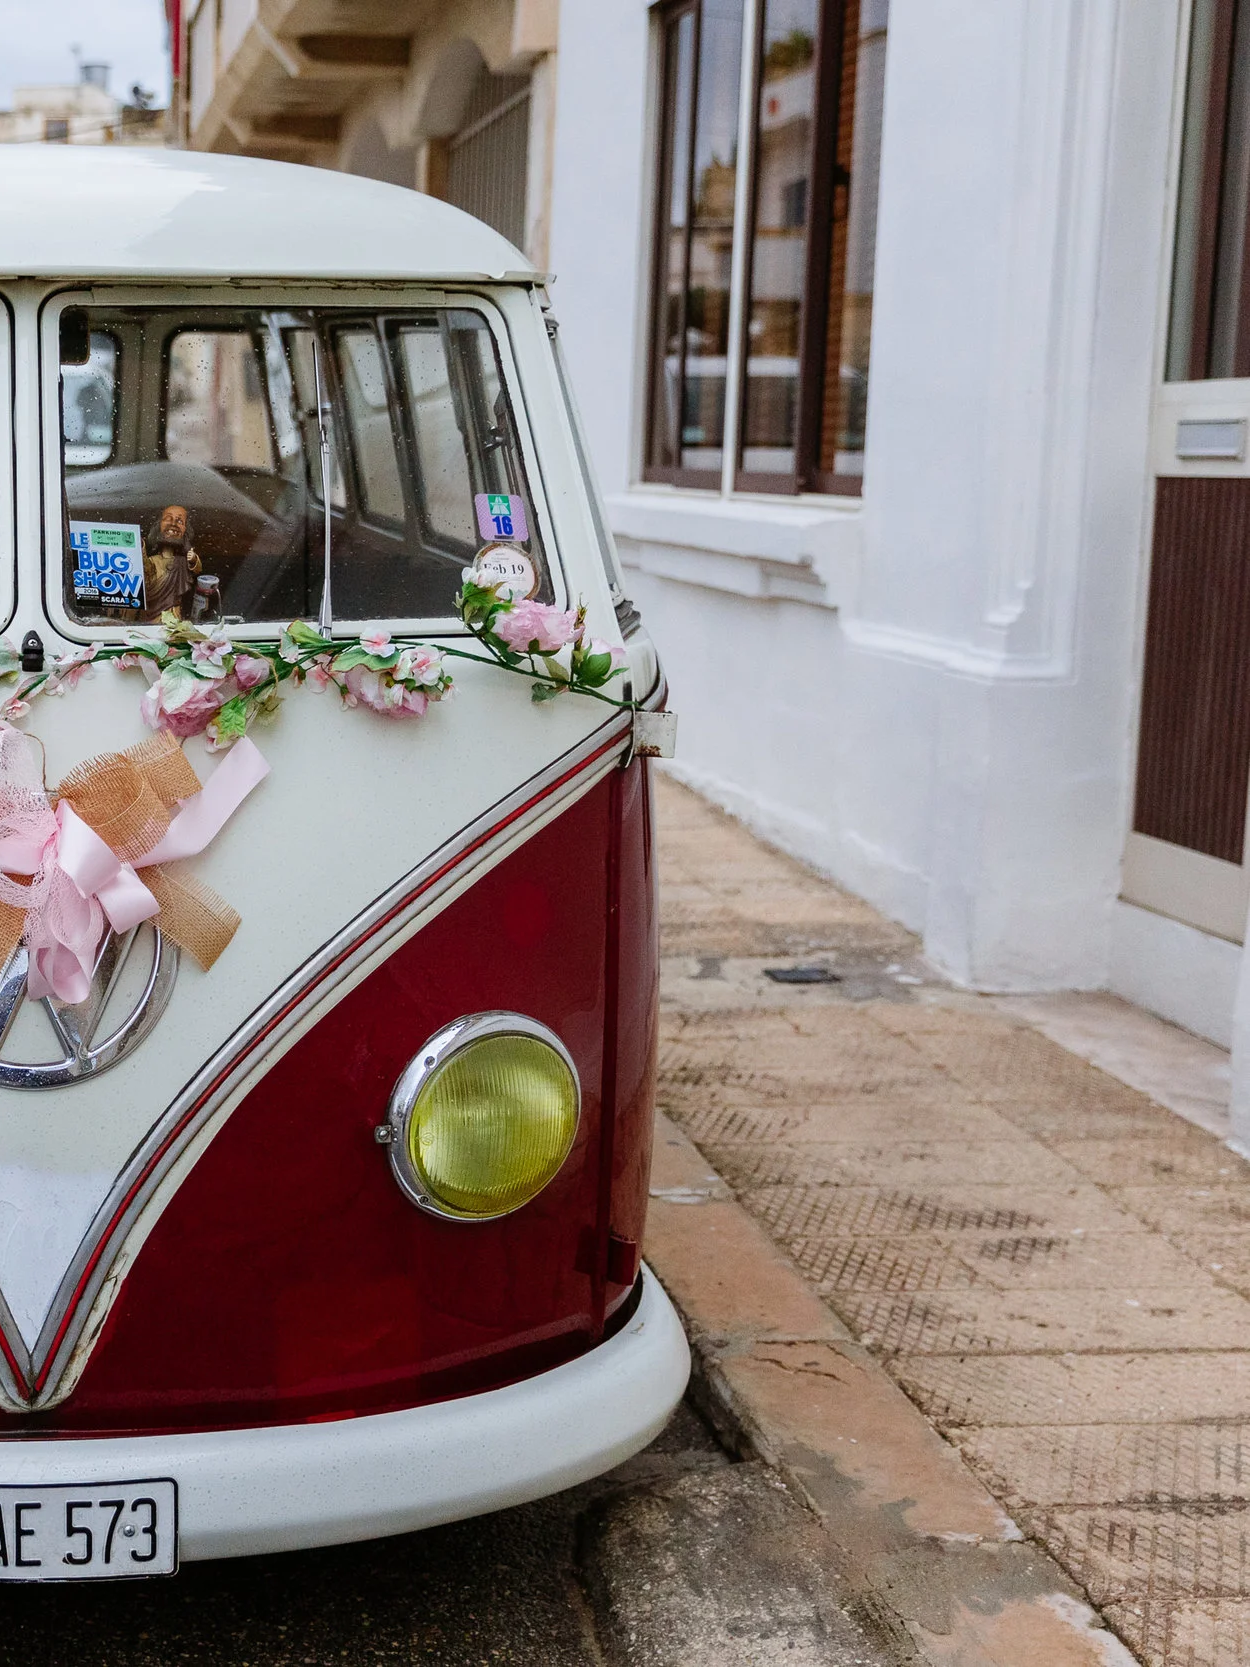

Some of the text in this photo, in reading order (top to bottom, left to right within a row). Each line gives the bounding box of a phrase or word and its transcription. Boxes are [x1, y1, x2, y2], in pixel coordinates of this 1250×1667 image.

[492, 515, 514, 536] 16
[70, 532, 89, 549] LE
[78, 551, 130, 572] BUG
[512, 563, 525, 575] 19
[73, 570, 142, 598] SHOW
[64, 1497, 157, 1565] 573
